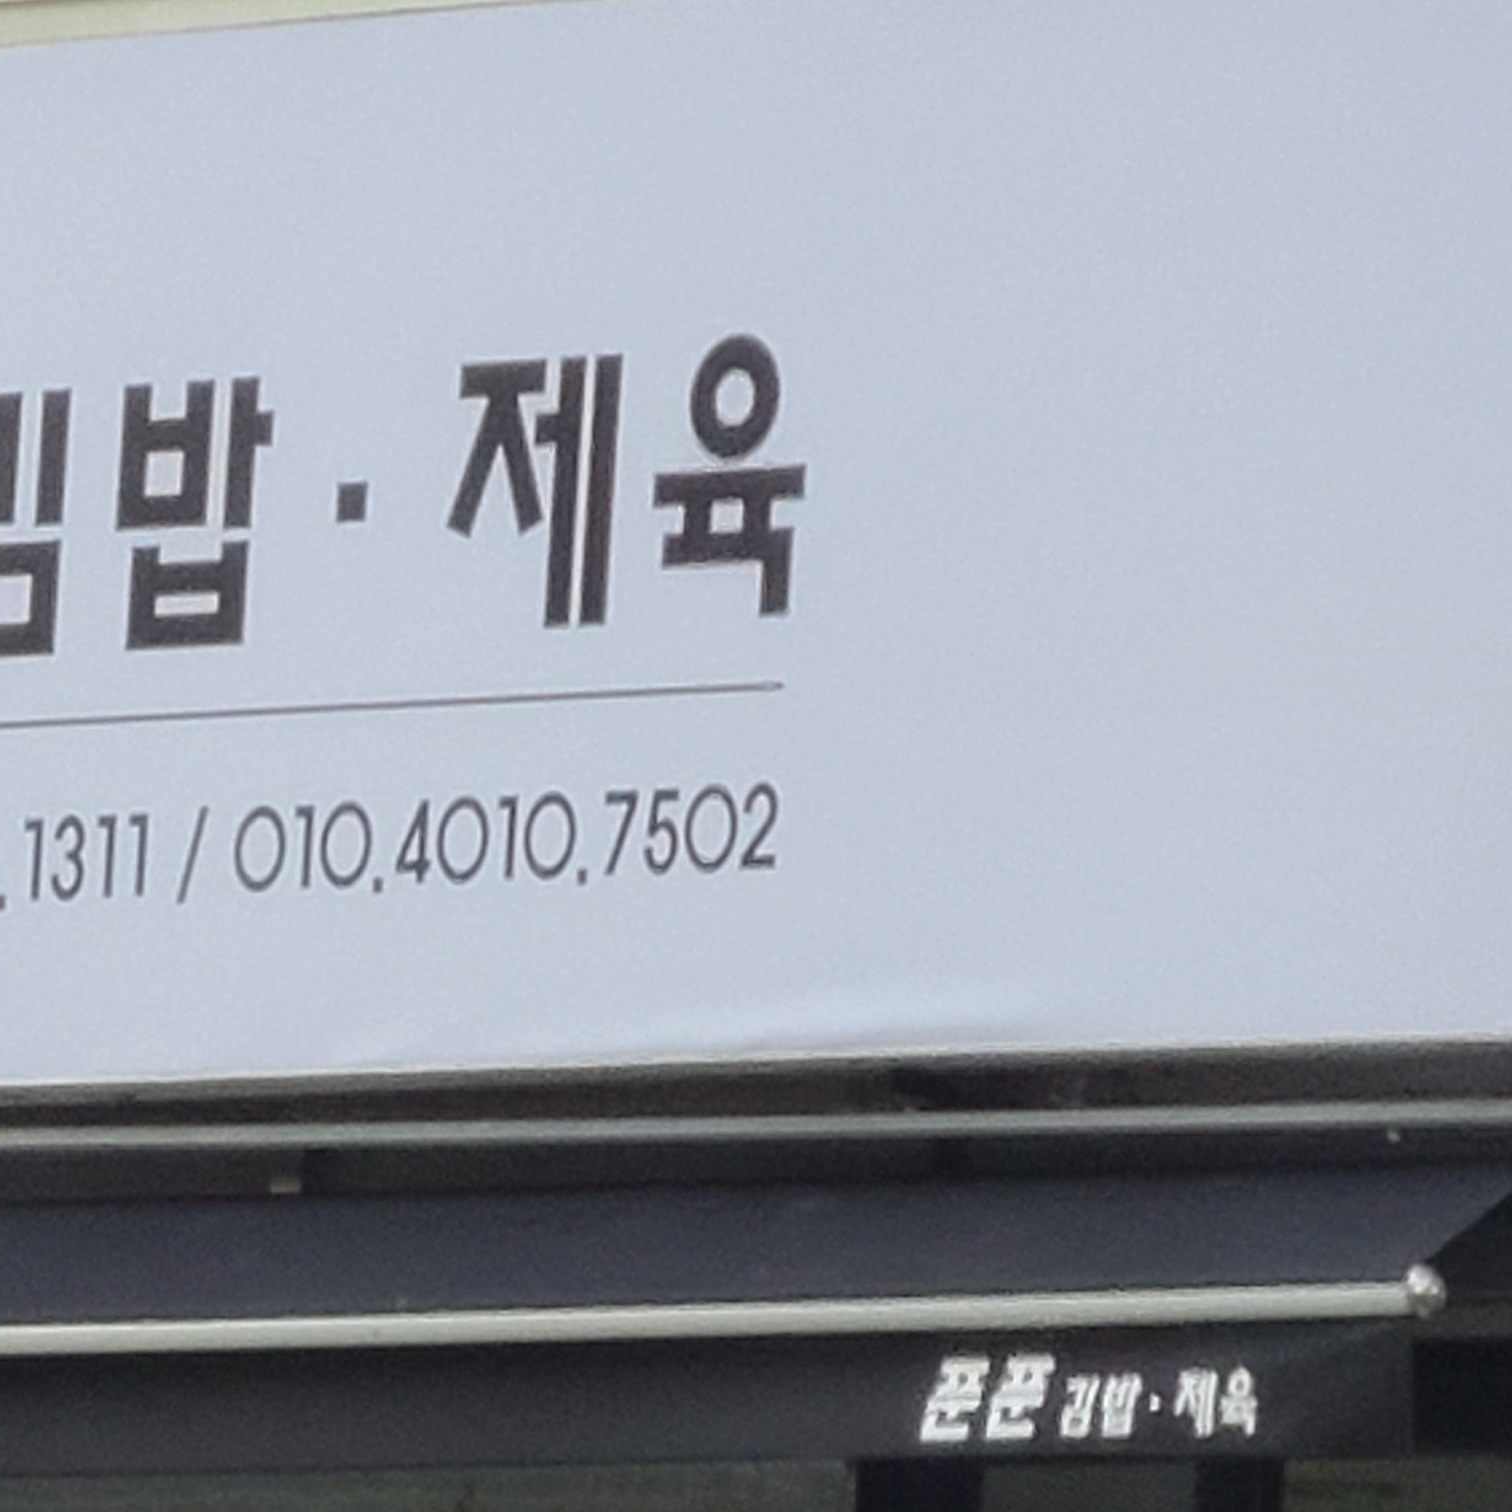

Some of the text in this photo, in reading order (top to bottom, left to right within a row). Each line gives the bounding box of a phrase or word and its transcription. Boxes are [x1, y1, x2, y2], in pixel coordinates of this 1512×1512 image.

[447, 334, 806, 629] 제육
[234, 782, 779, 894] 010.4010.7502
[918, 1353, 1057, 1444] 푼푼
[1059, 1372, 1144, 1440] 김밥
[1172, 1365, 1259, 1438] 제육
